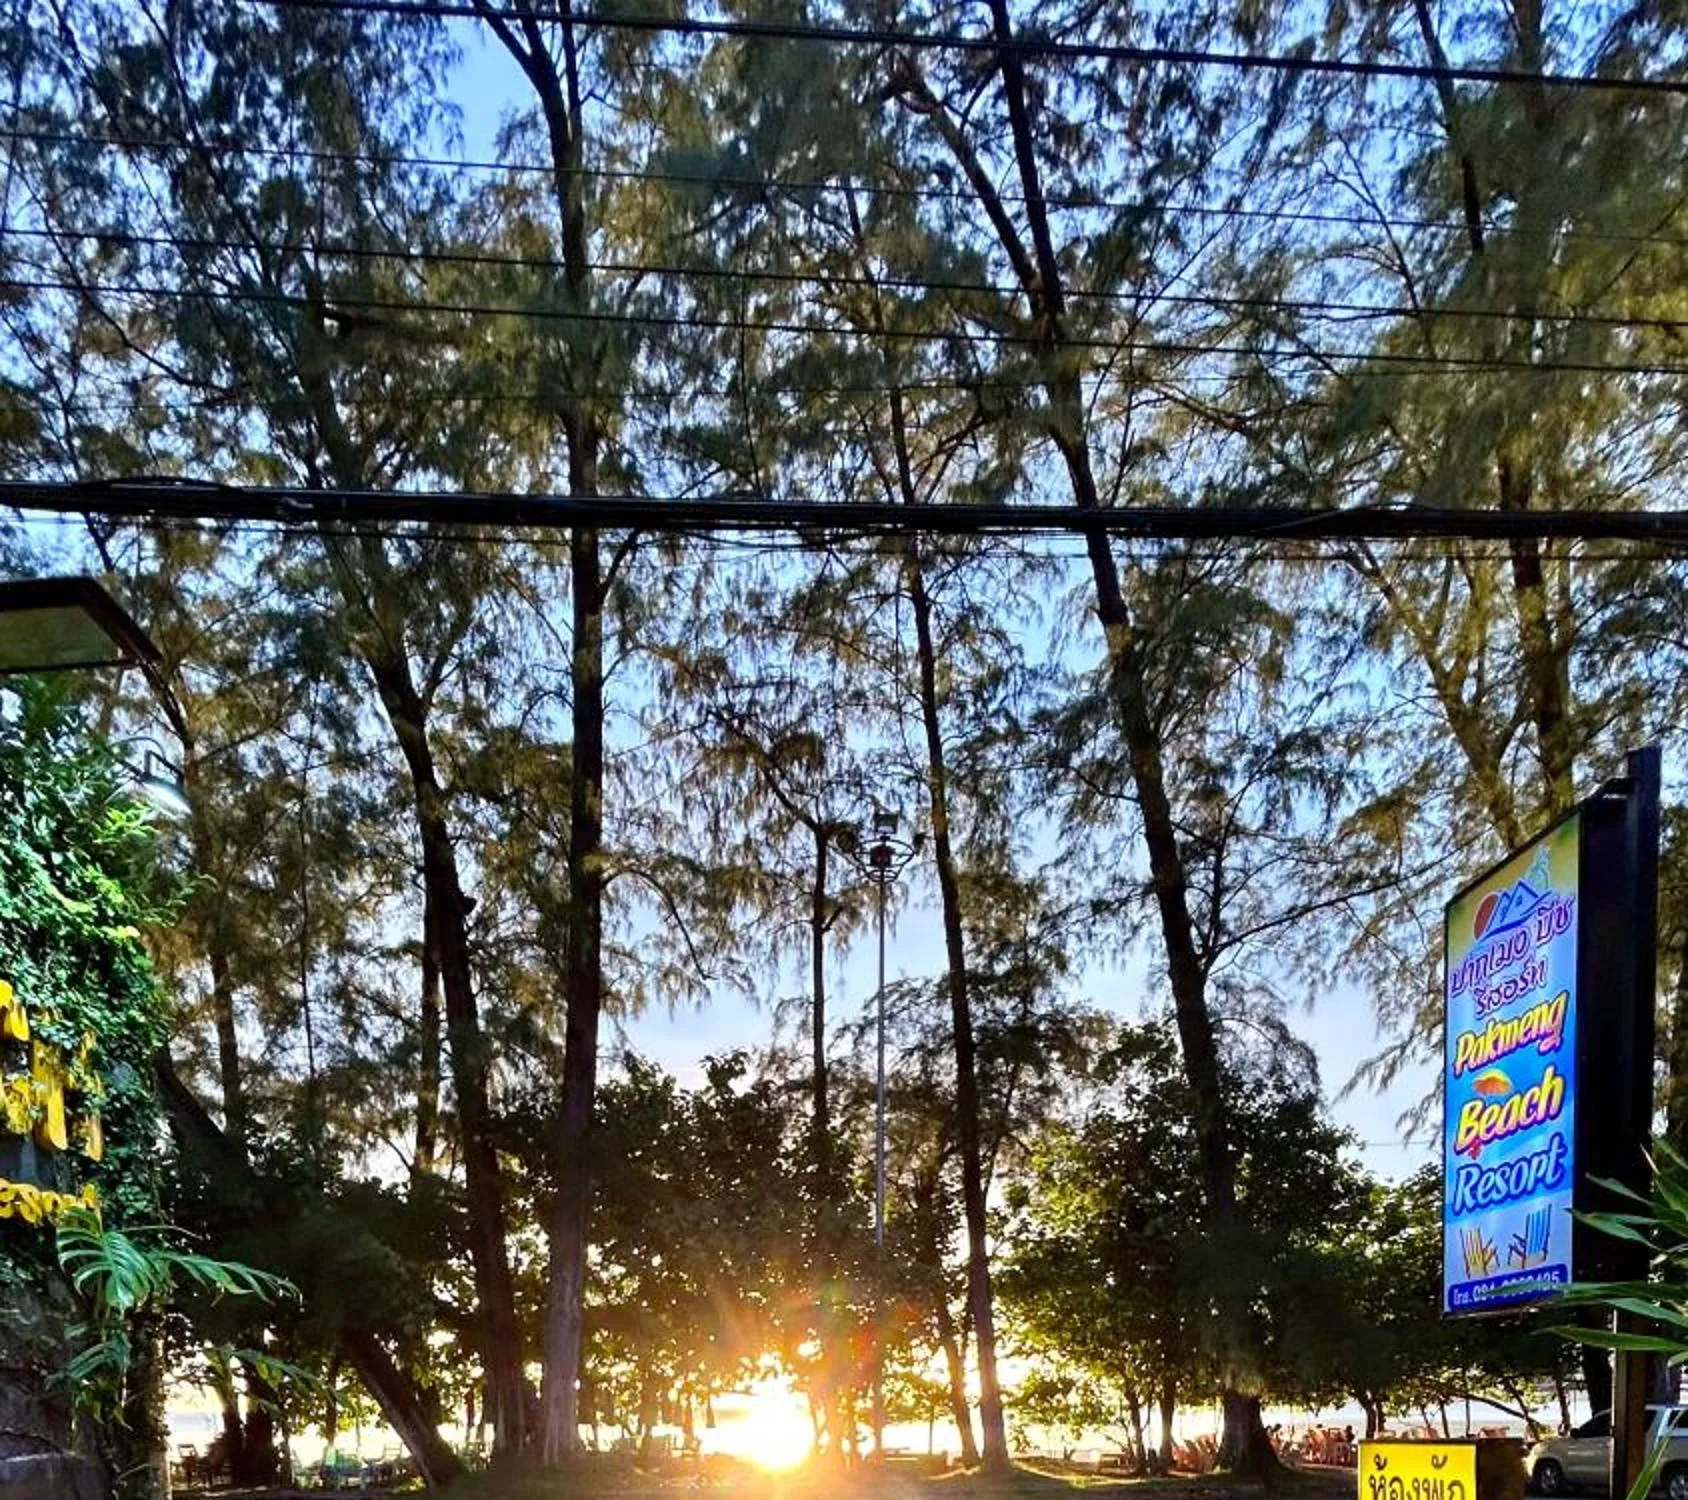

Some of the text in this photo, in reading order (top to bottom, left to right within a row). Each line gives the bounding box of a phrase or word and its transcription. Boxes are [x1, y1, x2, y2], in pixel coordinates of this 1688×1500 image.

[1454, 991, 1569, 1077] Pakmeng
[1454, 1065, 1566, 1154] Beach
[1453, 1132, 1567, 1215] Resort
